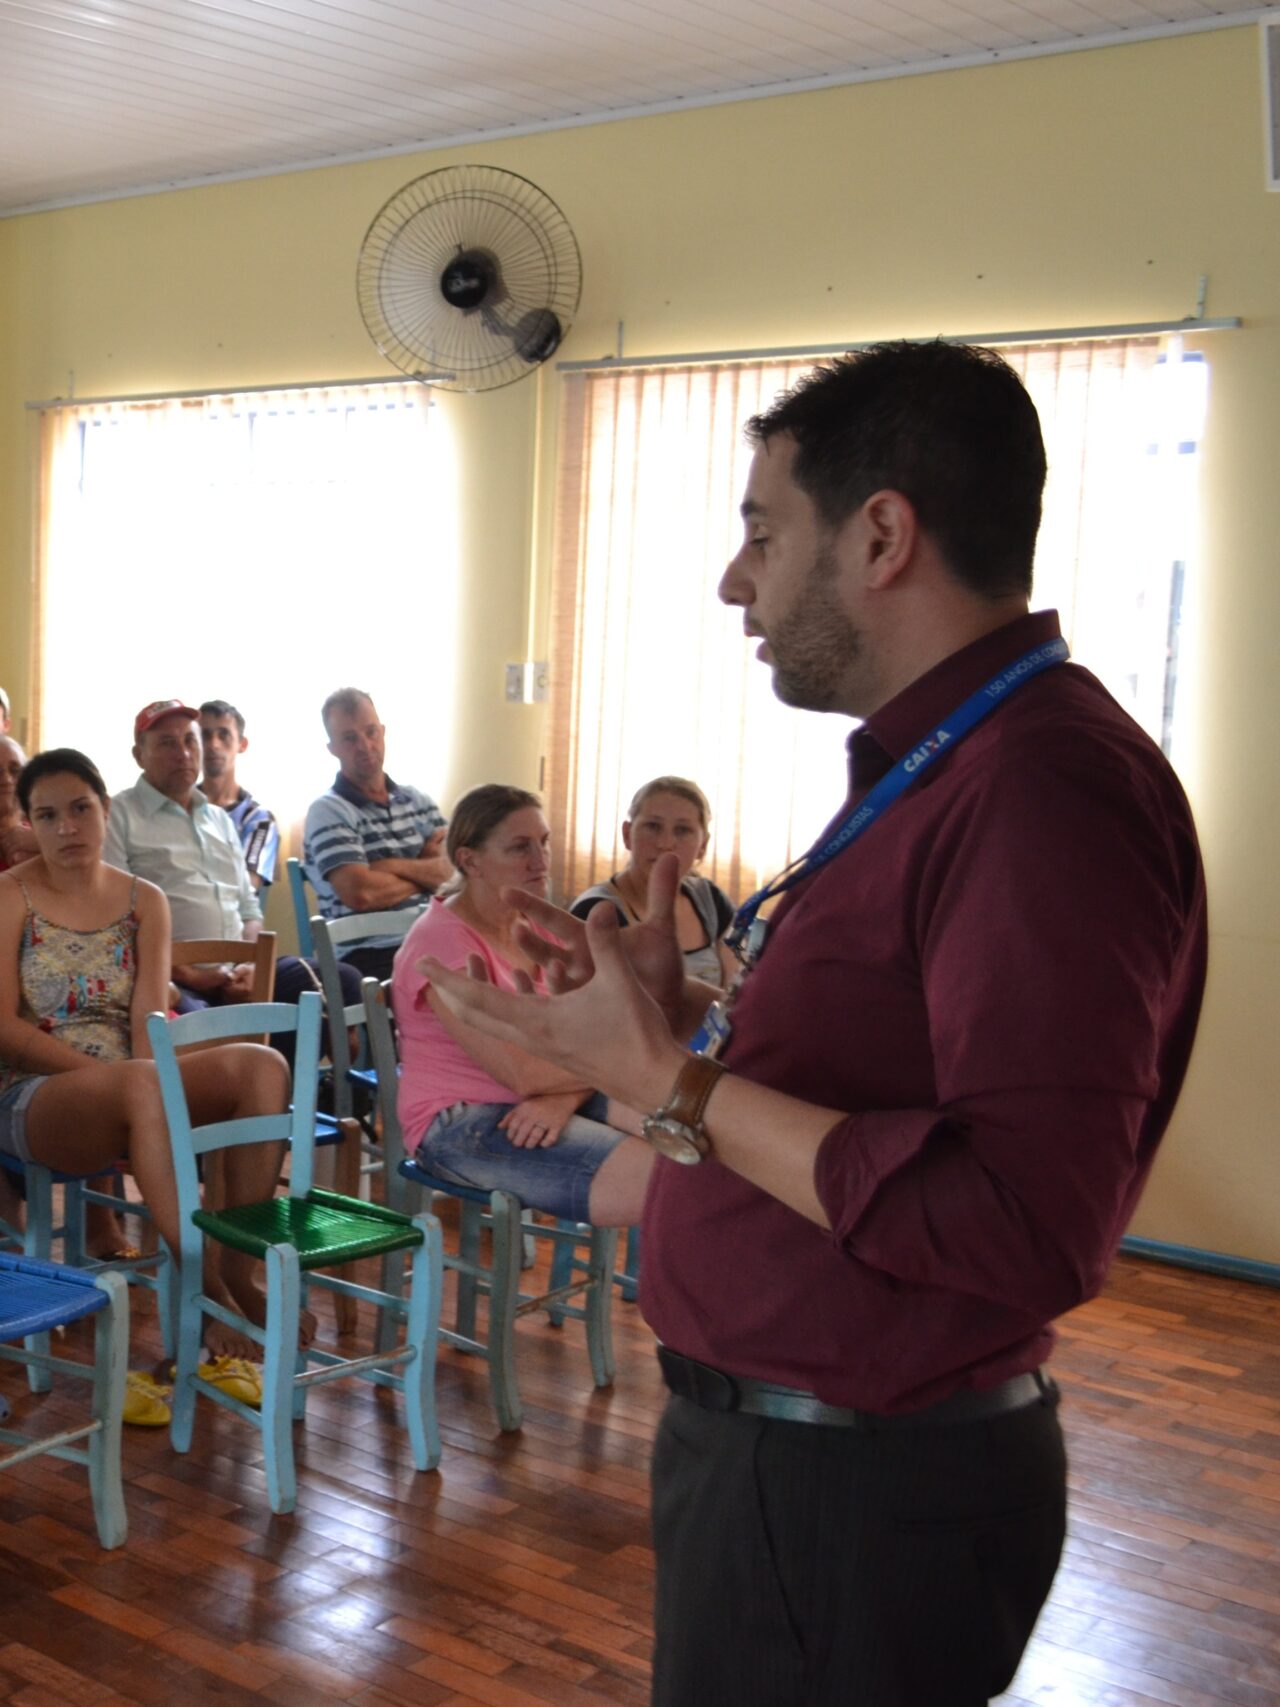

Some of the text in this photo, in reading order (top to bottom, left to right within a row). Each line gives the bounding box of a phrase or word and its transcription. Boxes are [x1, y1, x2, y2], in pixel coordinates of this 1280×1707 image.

[984, 680, 1006, 698] 150
[1004, 659, 1032, 683] ANOS
[903, 730, 951, 773] CAIXA
[824, 806, 874, 856] CONQUISTAS
